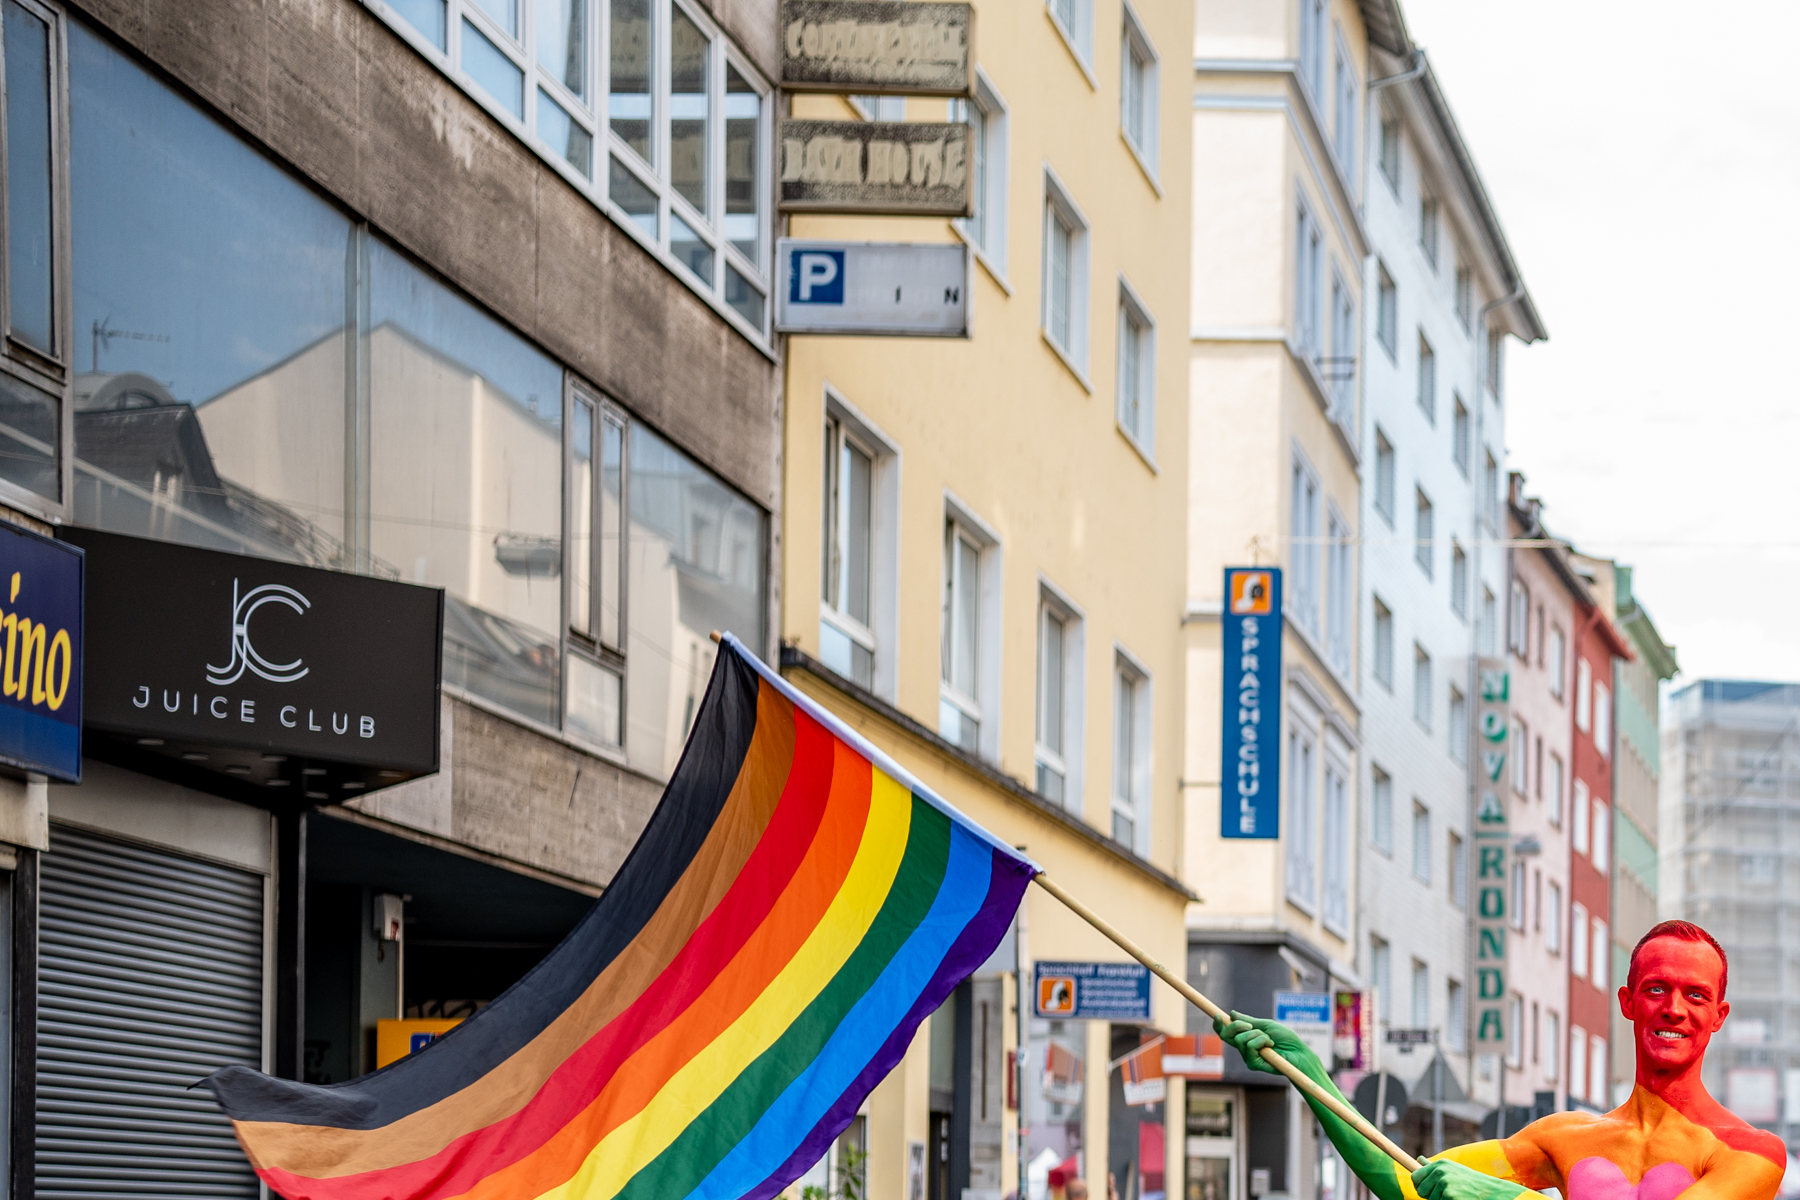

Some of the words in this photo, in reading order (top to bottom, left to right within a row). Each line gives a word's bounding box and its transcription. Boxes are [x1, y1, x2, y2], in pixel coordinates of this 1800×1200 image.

[799, 253, 839, 301] P
[944, 286, 959, 305] N
[0, 570, 72, 711] ino
[133, 685, 256, 723] JUICE
[280, 705, 376, 738] CLUB
[1238, 617, 1261, 834] SPRACHSCHULE
[1478, 669, 1510, 826] NOVA
[1477, 844, 1507, 1042] RONDA
